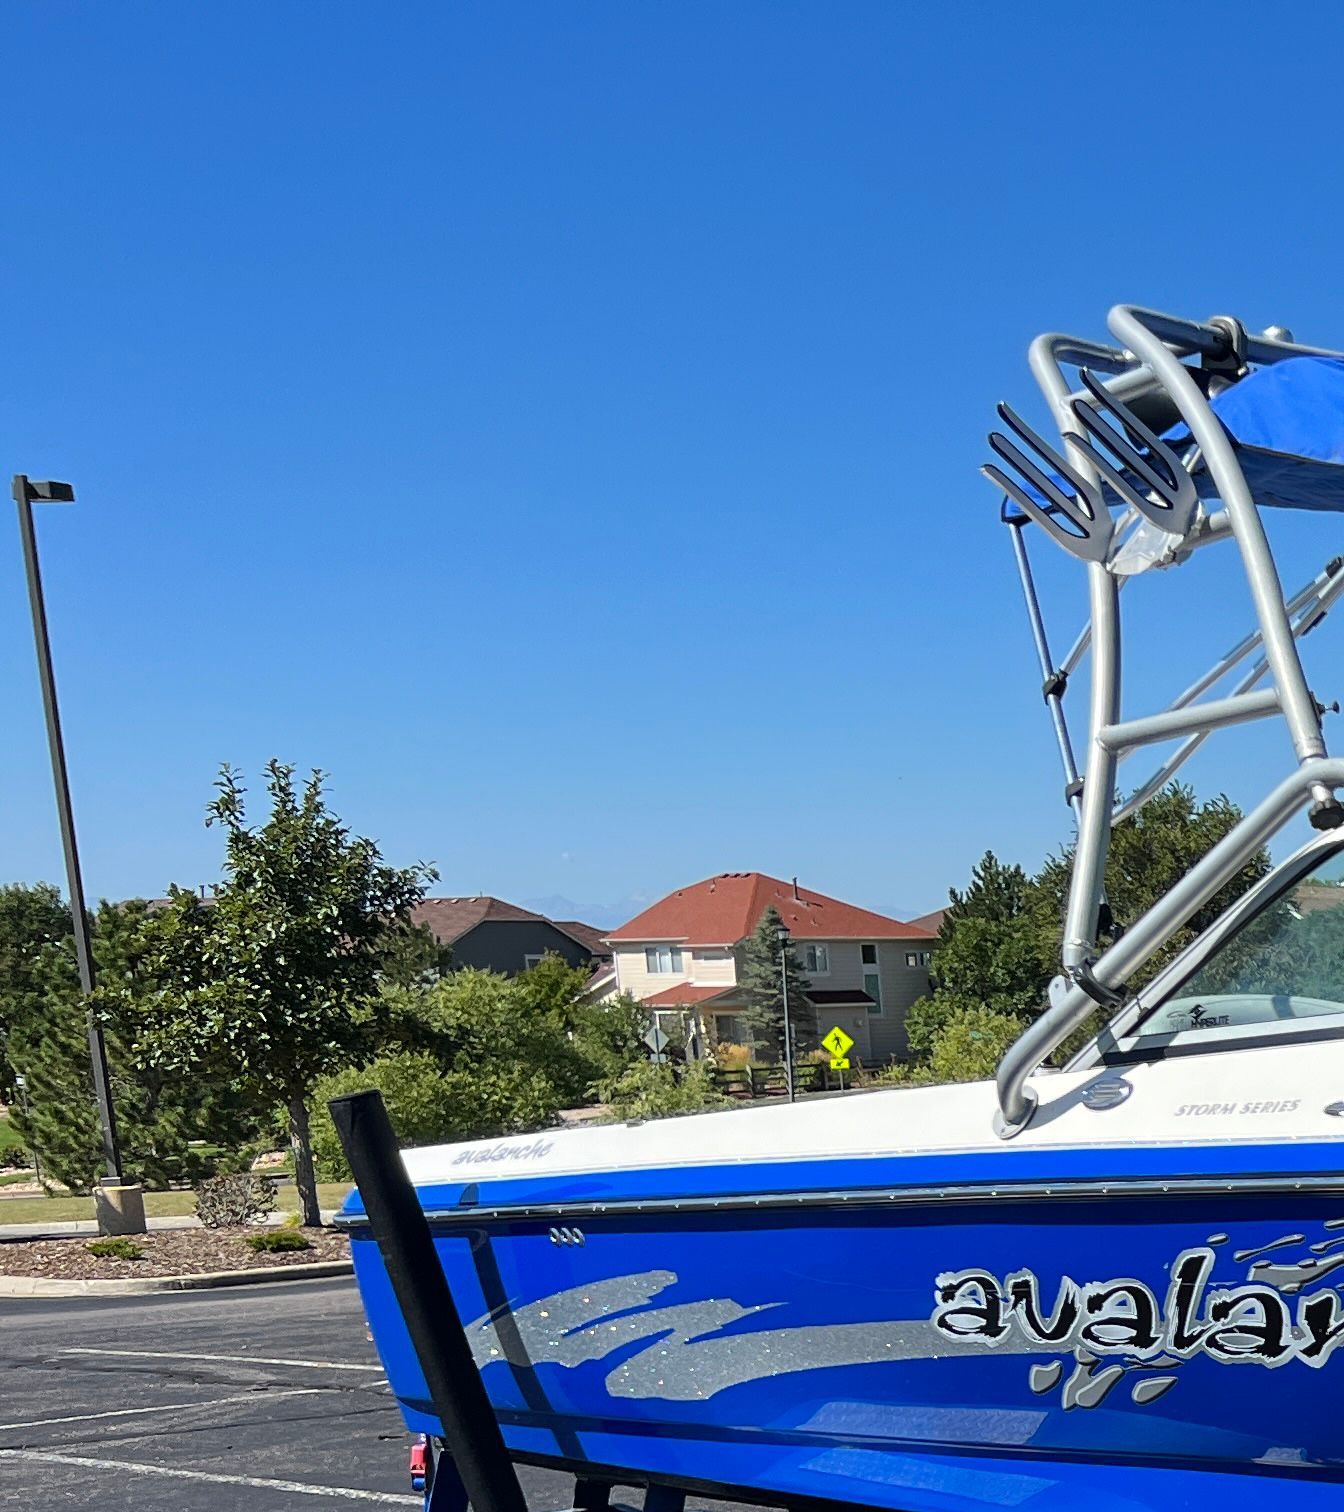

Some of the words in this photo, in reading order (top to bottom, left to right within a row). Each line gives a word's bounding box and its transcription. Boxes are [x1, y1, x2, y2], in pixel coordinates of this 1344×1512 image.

[1173, 1102, 1237, 1117] STORM
[1239, 1099, 1302, 1114] SERIES
[451, 1139, 555, 1165] avalanche
